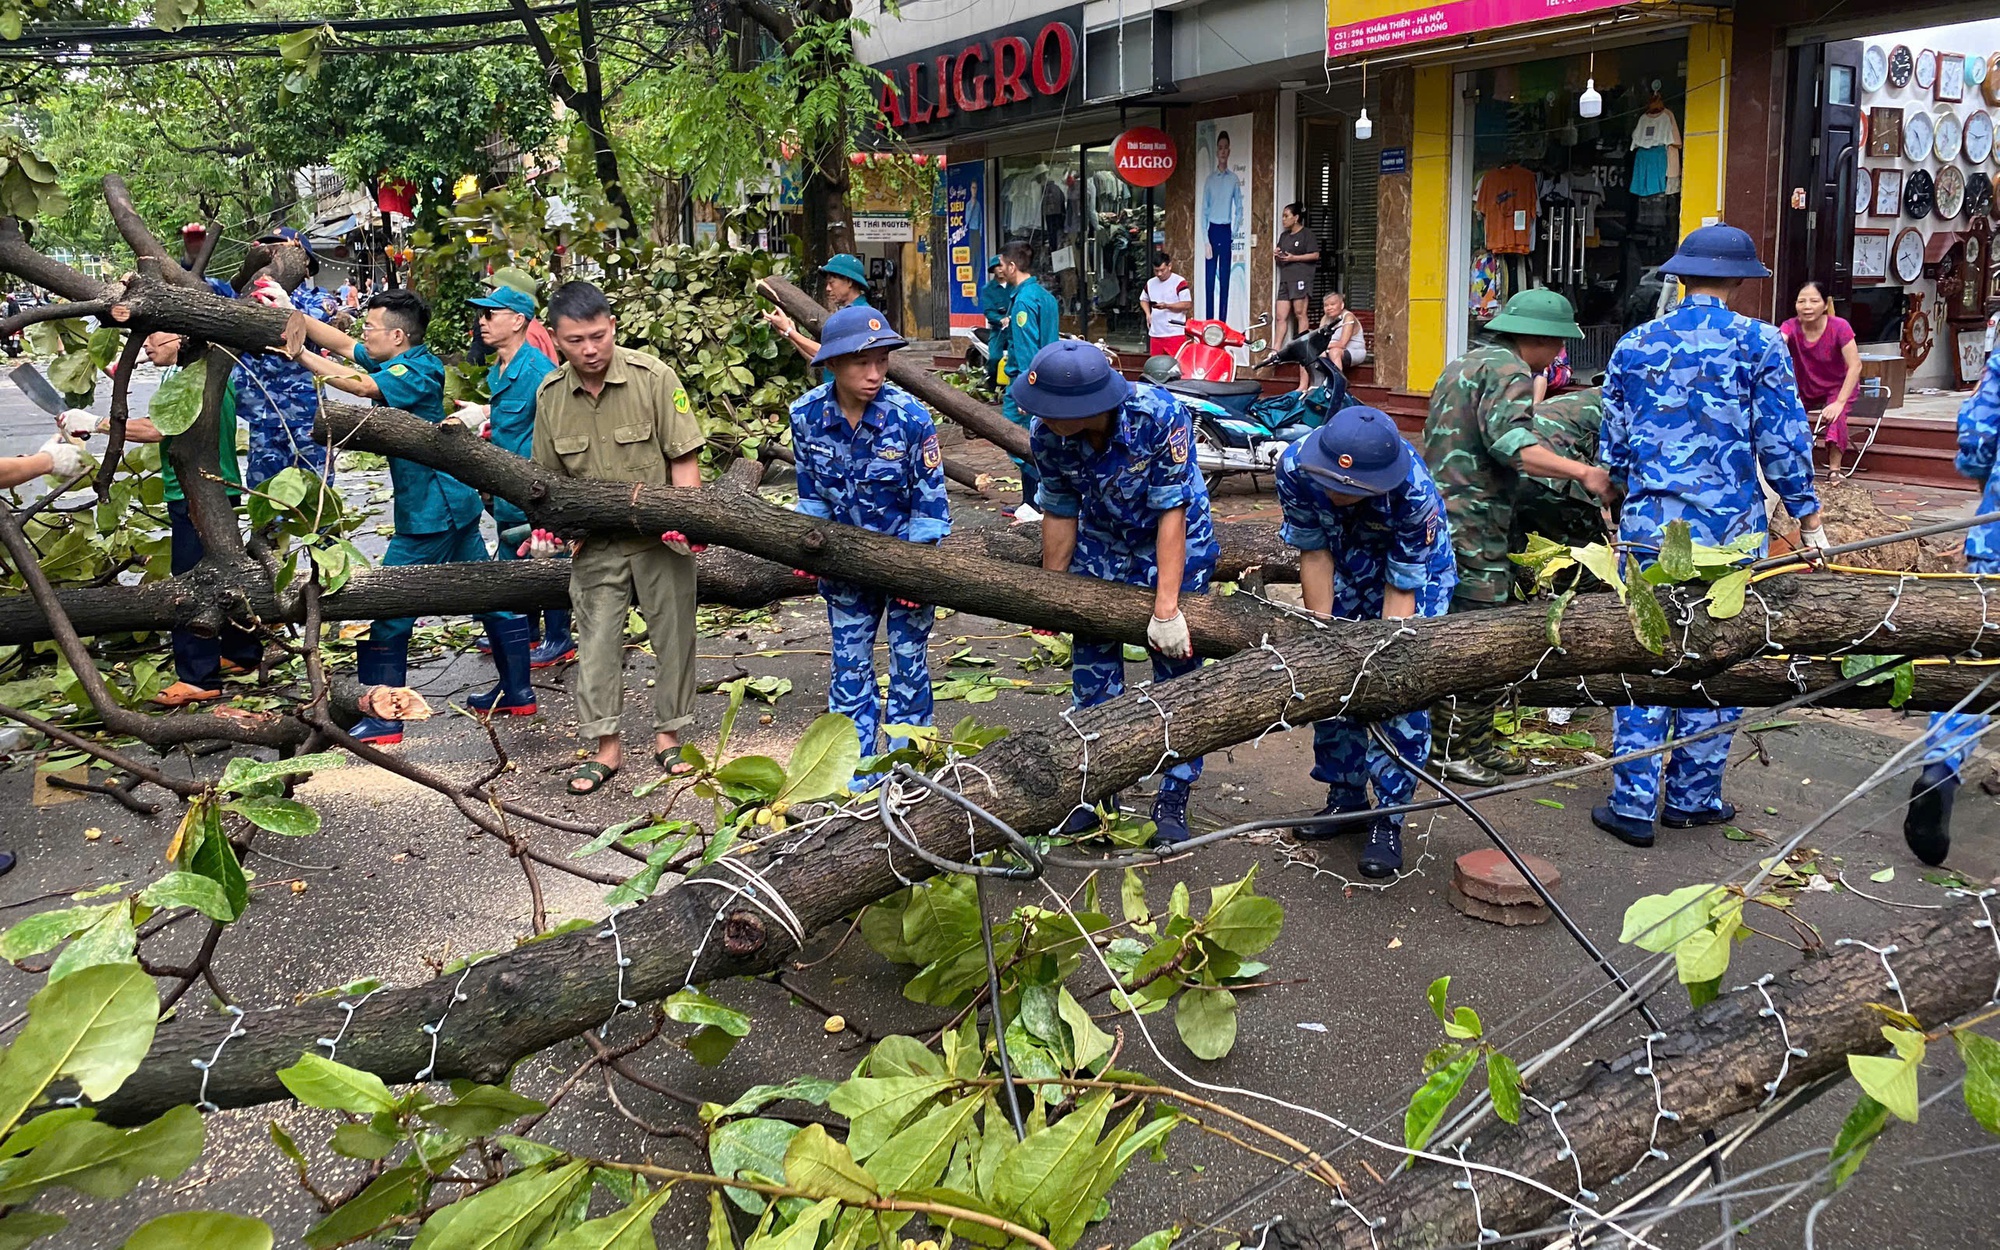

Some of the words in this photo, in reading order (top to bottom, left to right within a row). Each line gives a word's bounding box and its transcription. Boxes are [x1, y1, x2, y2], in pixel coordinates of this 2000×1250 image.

[1351, 28, 1364, 37] 296
[1417, 14, 1428, 24] HÀ
[1430, 11, 1444, 22] NỘI
[1412, 25, 1423, 36] HÀ
[875, 21, 1076, 130] ALIGRO
[1118, 156, 1173, 169] ALIGRO
[863, 219, 880, 228] THÁI
